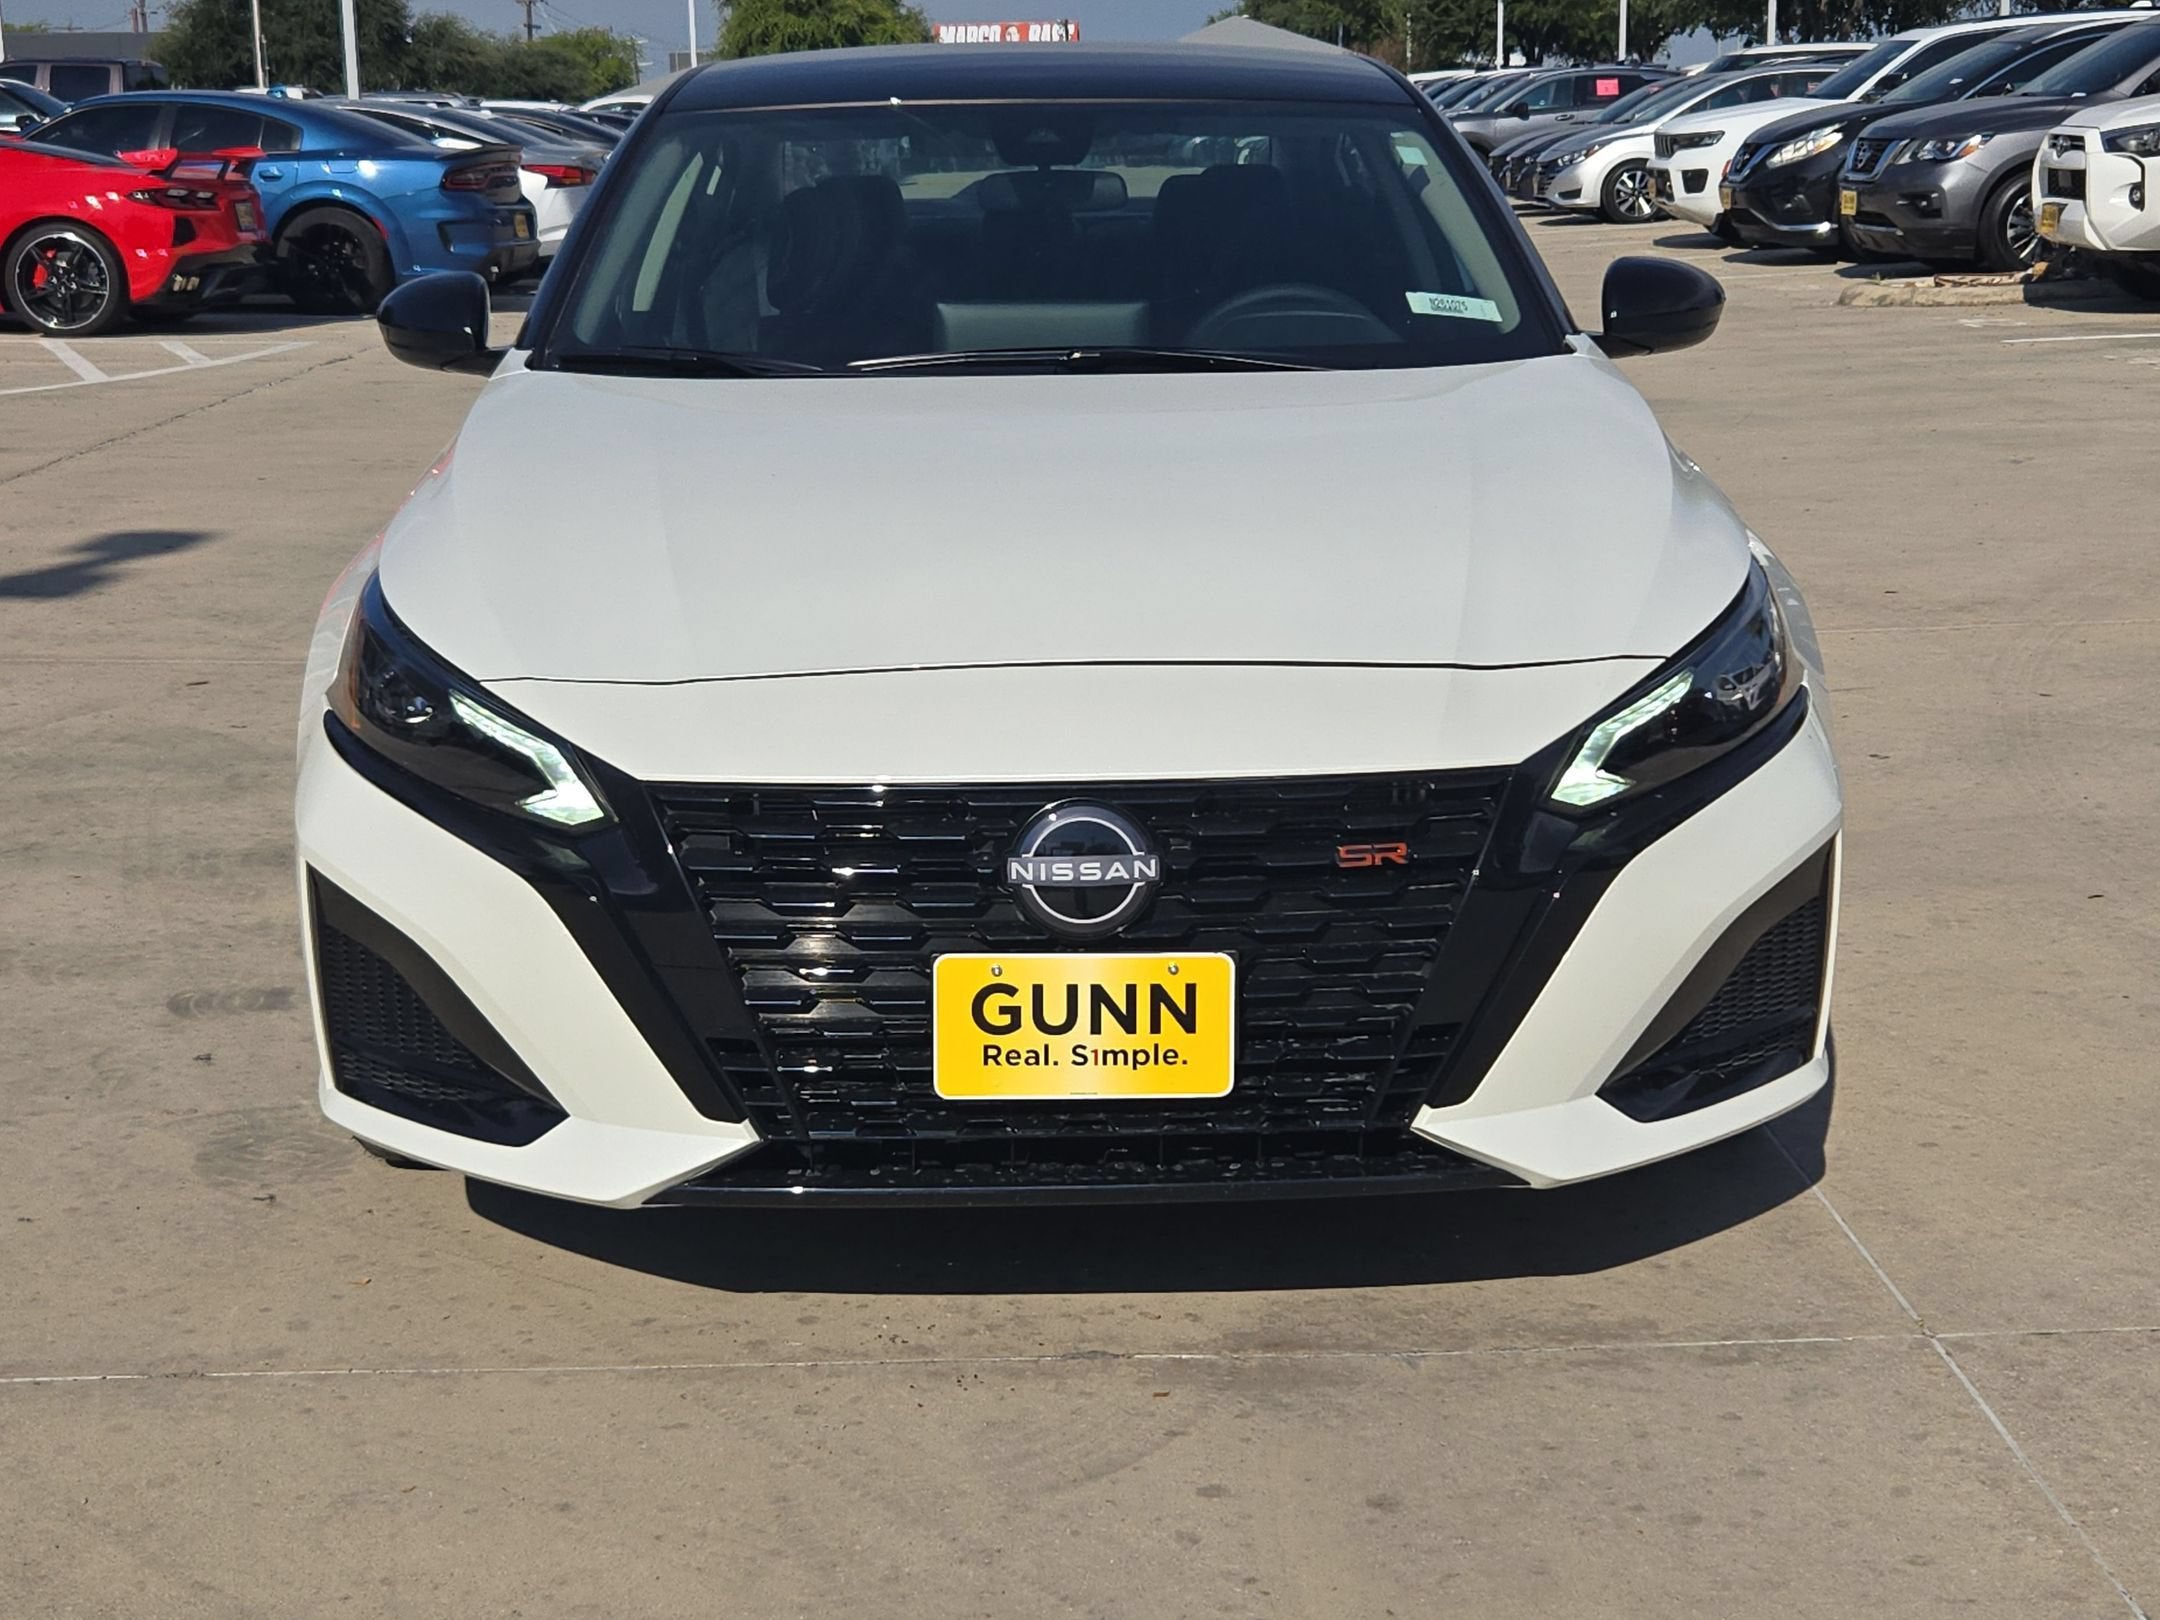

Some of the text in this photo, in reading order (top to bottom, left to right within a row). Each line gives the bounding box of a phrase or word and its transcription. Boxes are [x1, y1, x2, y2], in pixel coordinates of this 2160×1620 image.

[1337, 842, 1408, 867] SR
[1010, 859, 1156, 881] NISSAN
[971, 982, 1197, 1036] GUNN
[983, 1043, 1059, 1066] Real.
